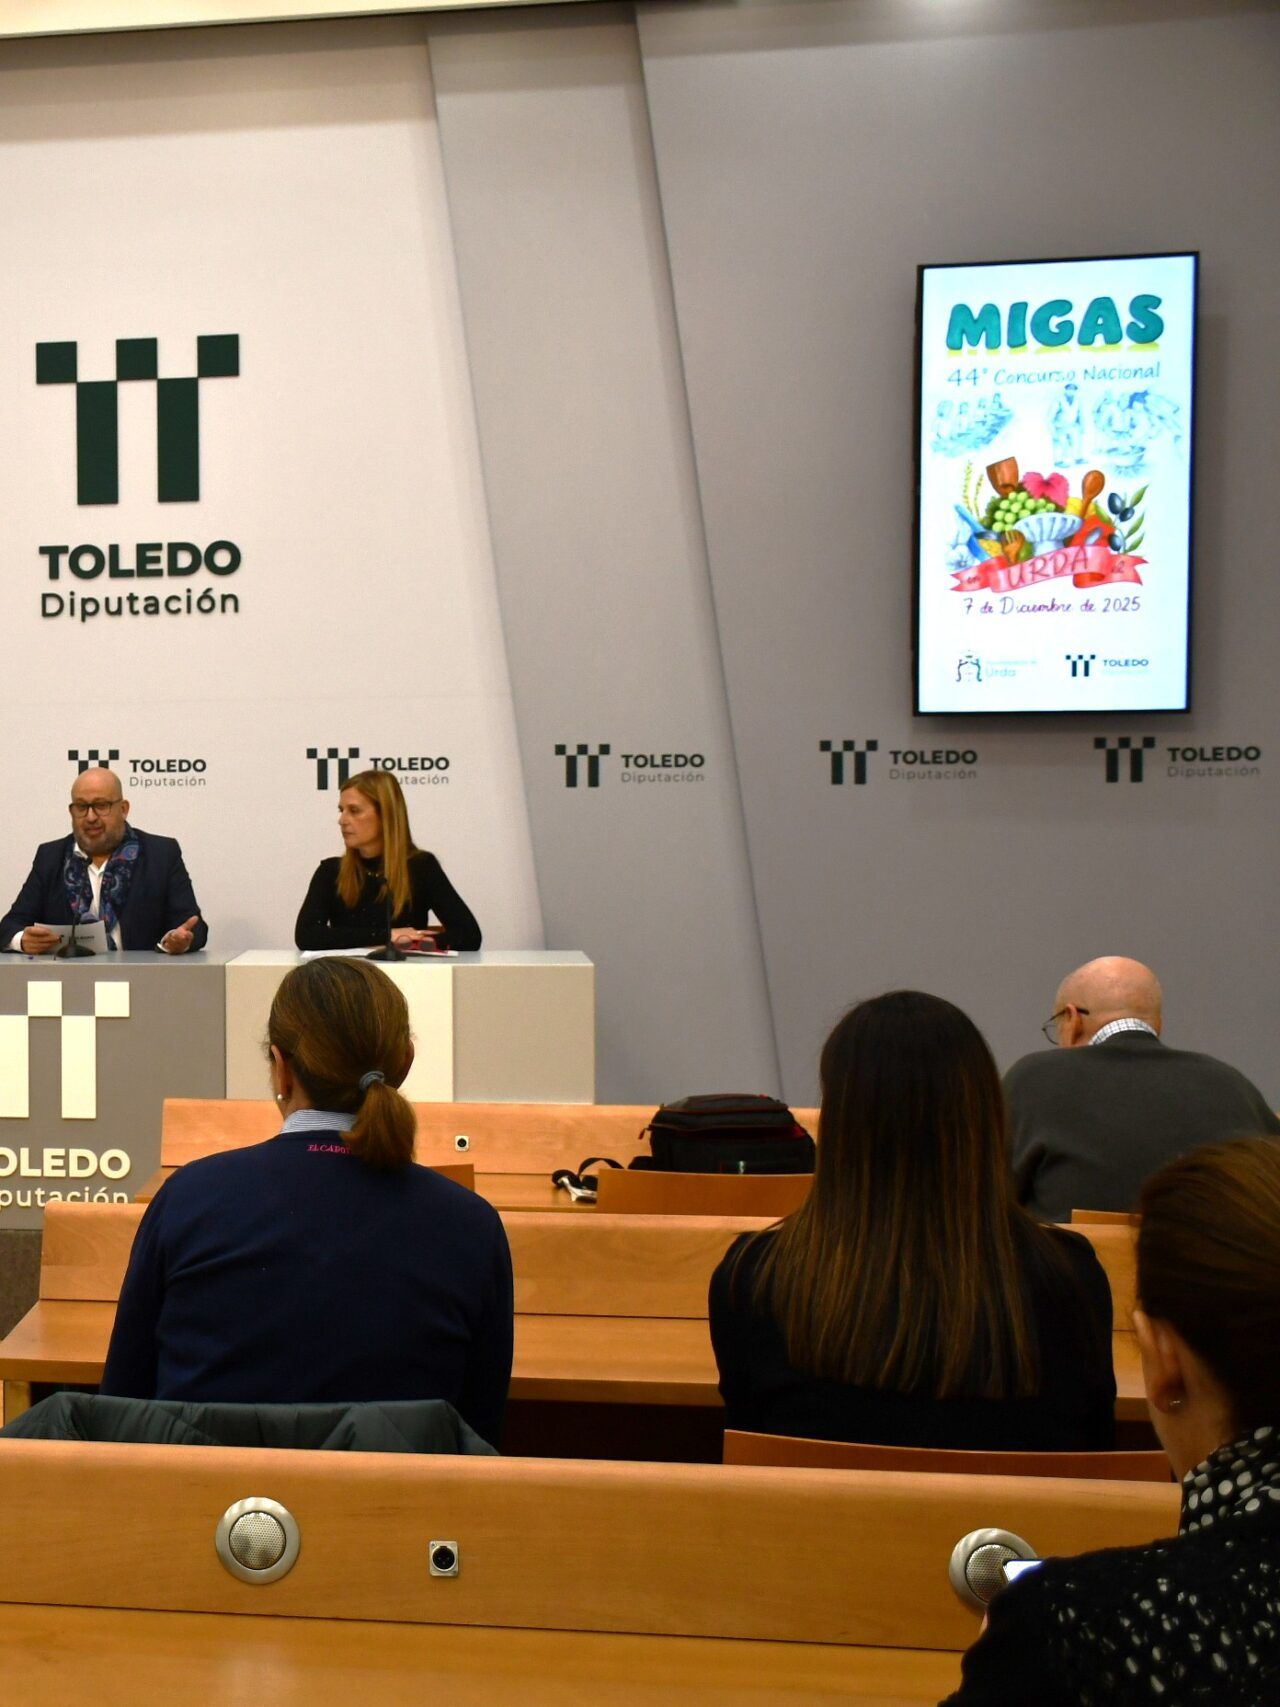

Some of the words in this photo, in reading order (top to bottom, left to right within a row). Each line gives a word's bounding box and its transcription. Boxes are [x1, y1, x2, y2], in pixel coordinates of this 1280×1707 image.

[946, 294, 1164, 351] MIGAS
[994, 368, 1076, 385] Concurso
[1083, 361, 1161, 381] Nacional
[38, 540, 241, 580] TOLEDO
[1007, 546, 1088, 588] URDA
[41, 587, 240, 623] Diputación
[963, 597, 973, 615] 7
[980, 601, 994, 613] de
[999, 596, 1072, 615] Diciembre
[1080, 598, 1096, 612] de
[1102, 596, 1141, 613] 2025
[1102, 658, 1149, 668] TOLEDO
[621, 753, 705, 768] TOLEDO
[889, 750, 978, 765] TOLEDO
[1167, 746, 1261, 762] TOLEDO
[129, 758, 207, 773] TOLEDO
[369, 757, 450, 771] TOLEDO
[1167, 763, 1261, 778] Diputación
[129, 775, 207, 788] Diputación
[399, 773, 450, 785] tación
[621, 770, 705, 784] Diputación
[889, 767, 978, 781] Diputación
